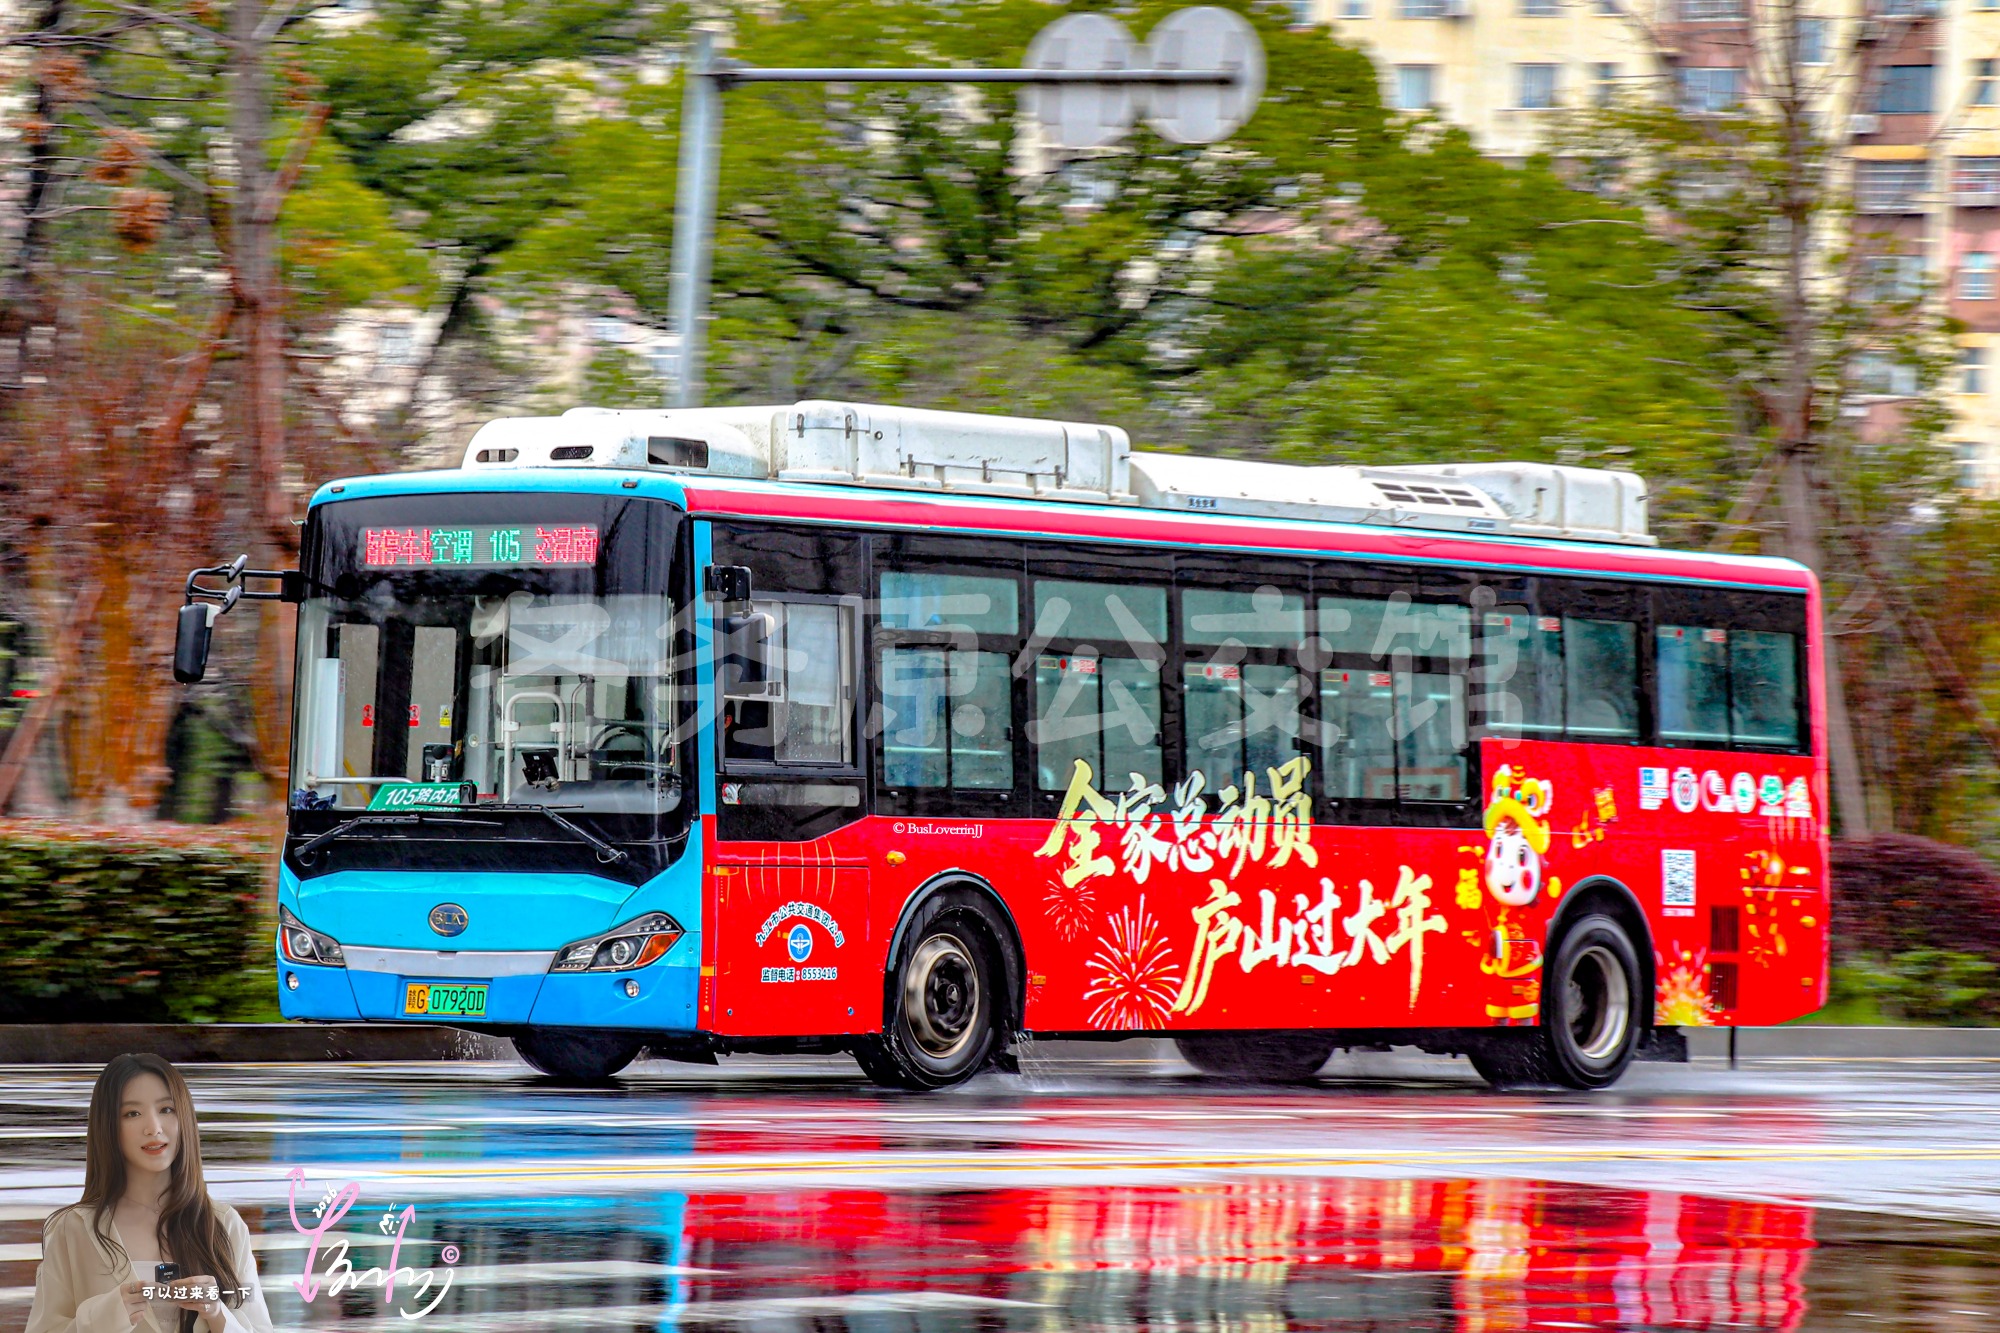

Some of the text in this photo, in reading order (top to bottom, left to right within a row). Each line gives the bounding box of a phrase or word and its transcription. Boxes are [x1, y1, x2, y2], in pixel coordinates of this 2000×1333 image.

[430, 529, 474, 564] 空调
[490, 530, 521, 562] 105
[1034, 756, 1319, 888] 全家总动员
[756, 901, 845, 948] 九江市公共交通集团公司
[1171, 865, 1448, 1016] 庐山过大年
